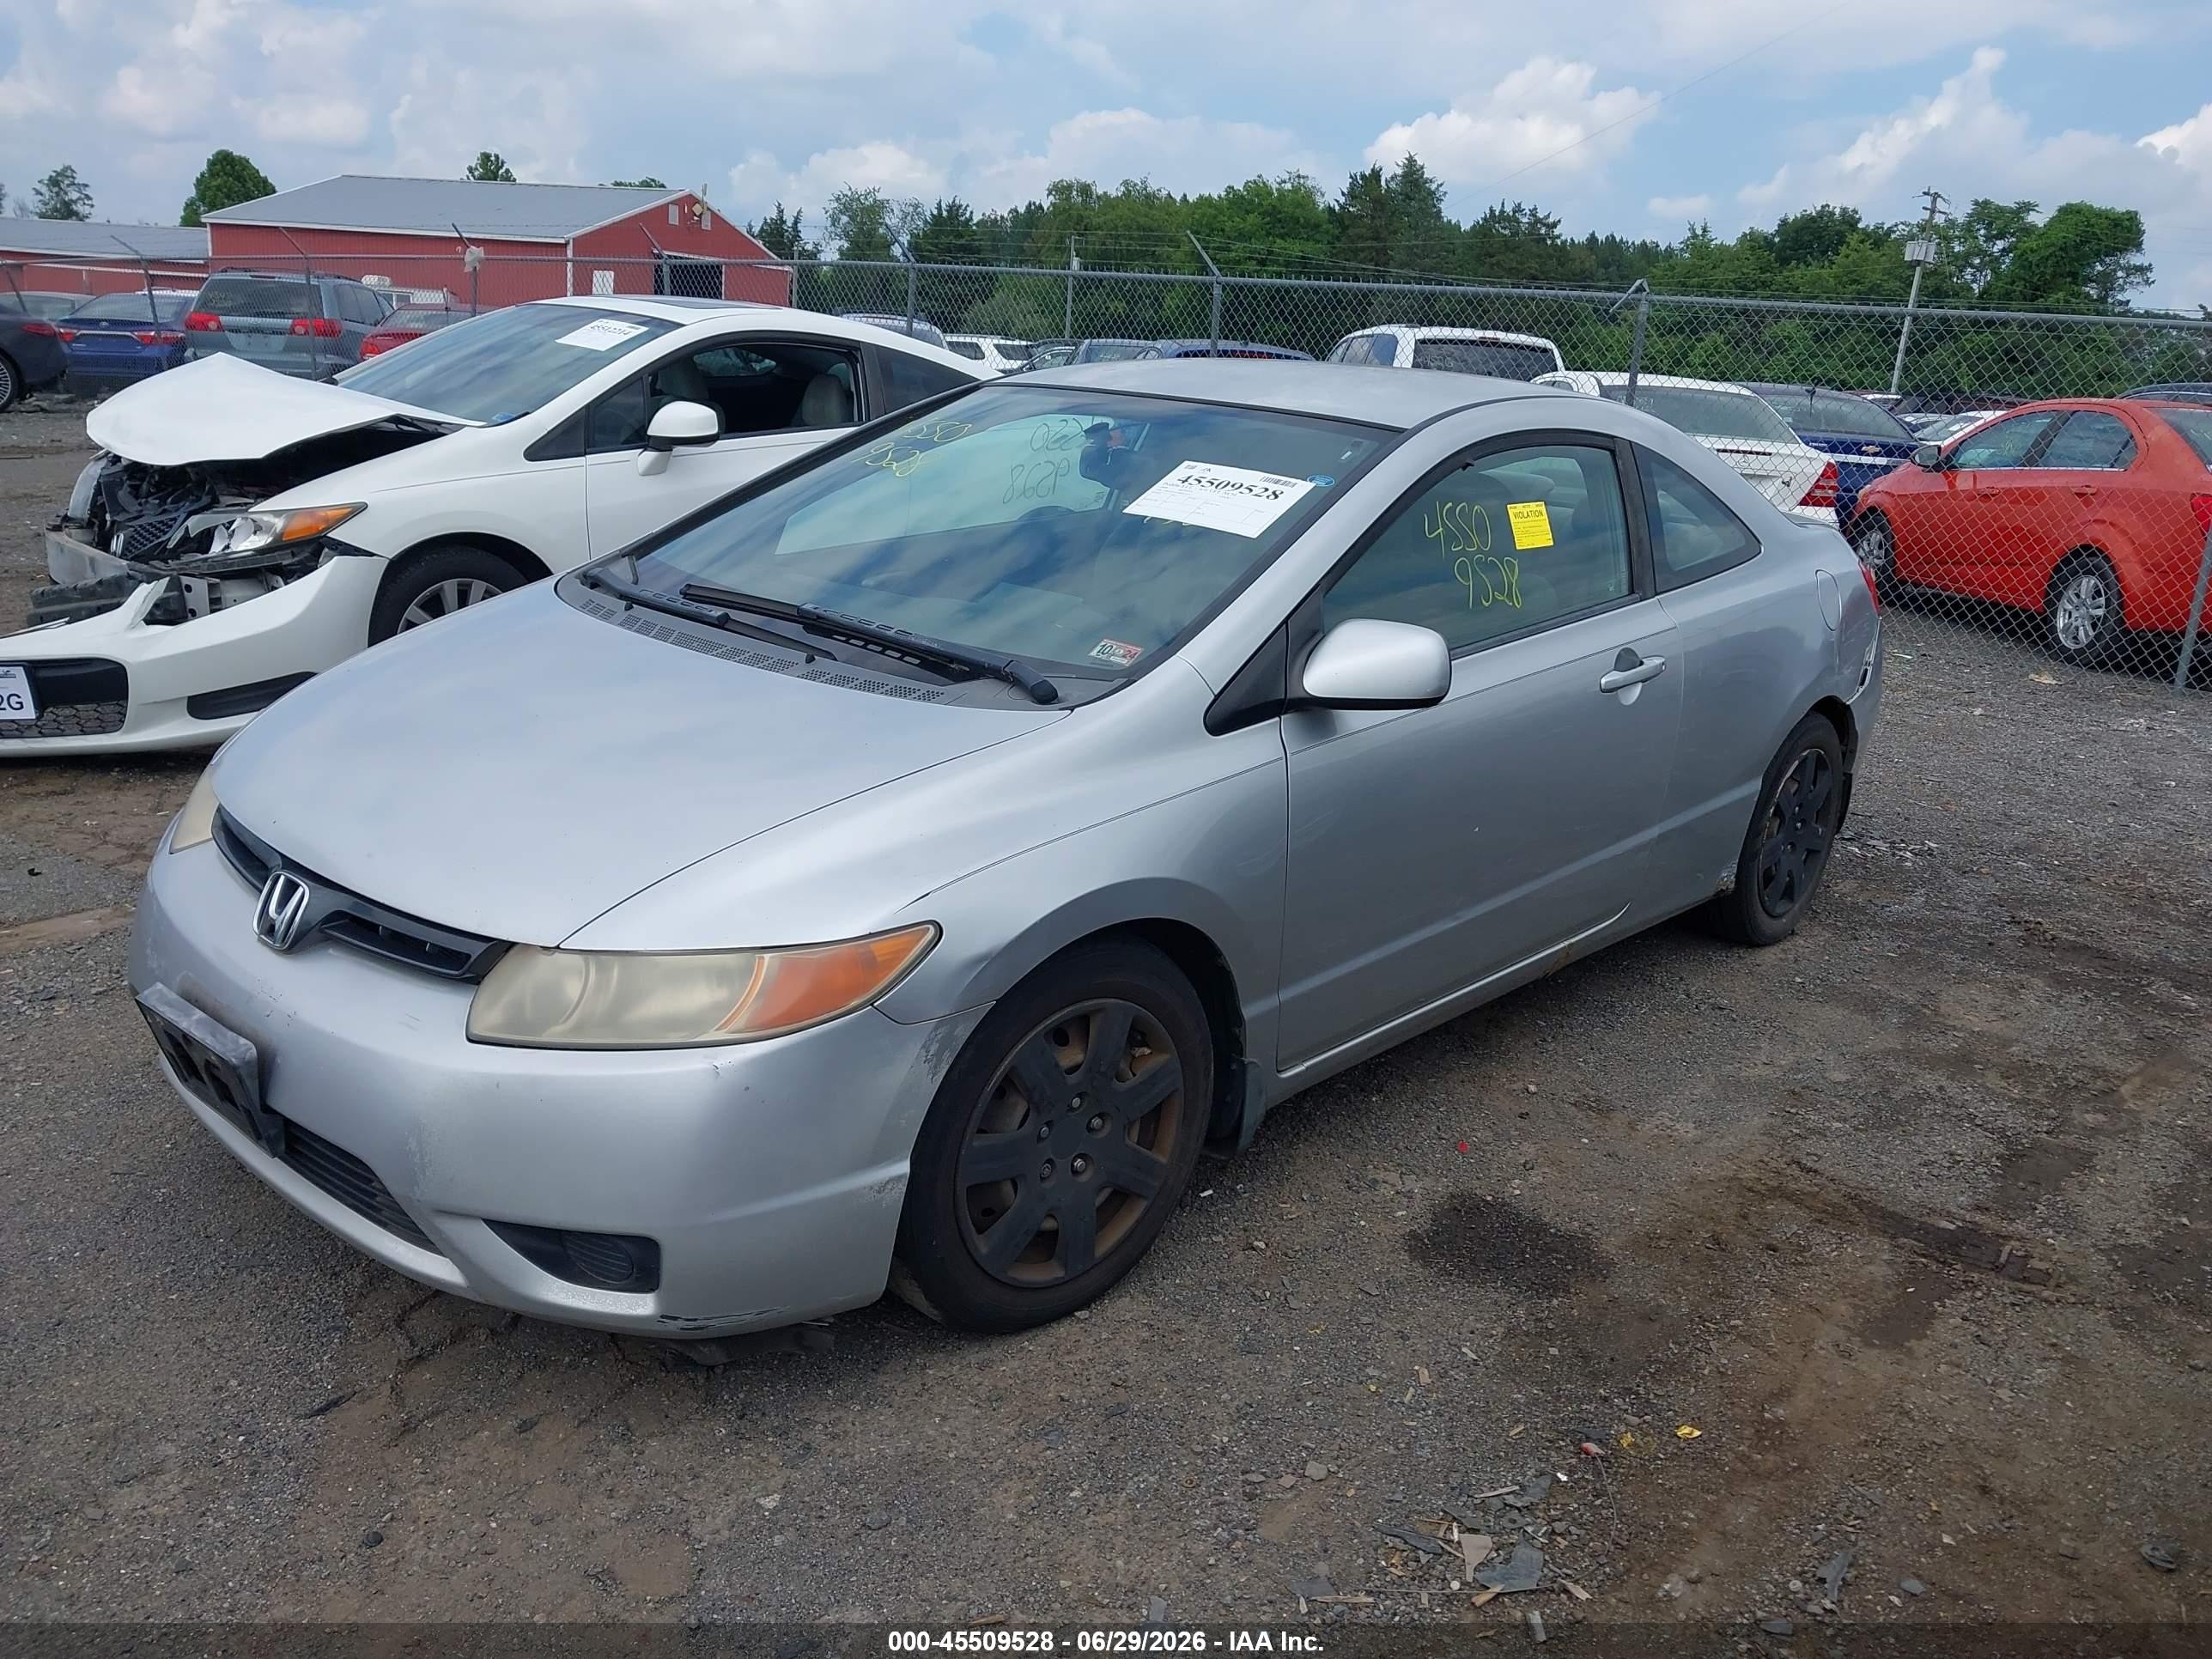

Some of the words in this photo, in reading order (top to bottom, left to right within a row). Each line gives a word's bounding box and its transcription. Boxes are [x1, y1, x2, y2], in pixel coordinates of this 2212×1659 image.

[1177, 474, 1285, 501] 45509528
[1512, 509, 1544, 520] VIOLATION
[1455, 555, 1522, 609] 9528
[1097, 643, 1114, 655] 10
